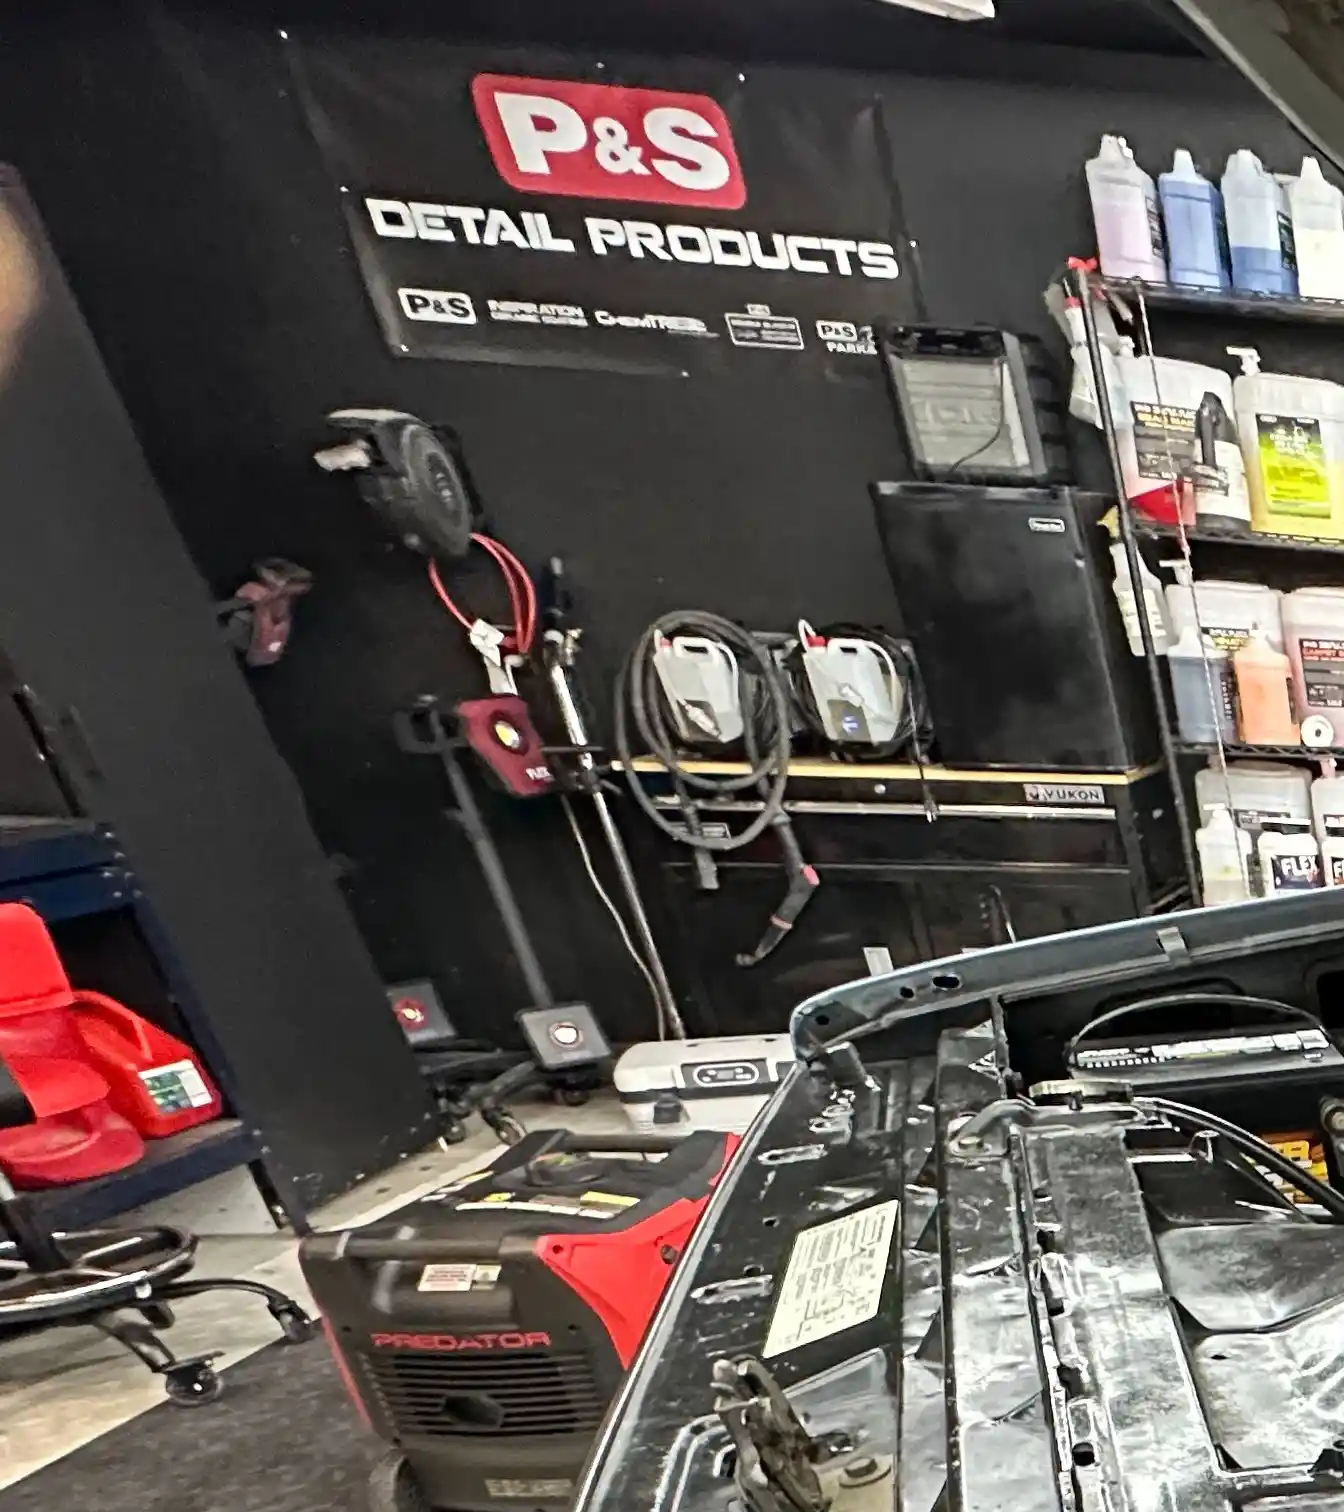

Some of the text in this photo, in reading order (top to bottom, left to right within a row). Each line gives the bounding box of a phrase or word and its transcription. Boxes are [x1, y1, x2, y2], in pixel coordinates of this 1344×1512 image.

[494, 92, 731, 191] P&S
[366, 199, 899, 279] DETAIL PRODUCTS
[406, 294, 472, 318] P&S
[1044, 788, 1100, 801] YUKON
[1281, 855, 1317, 877] FLEX
[371, 1332, 552, 1350] PREDATOR
